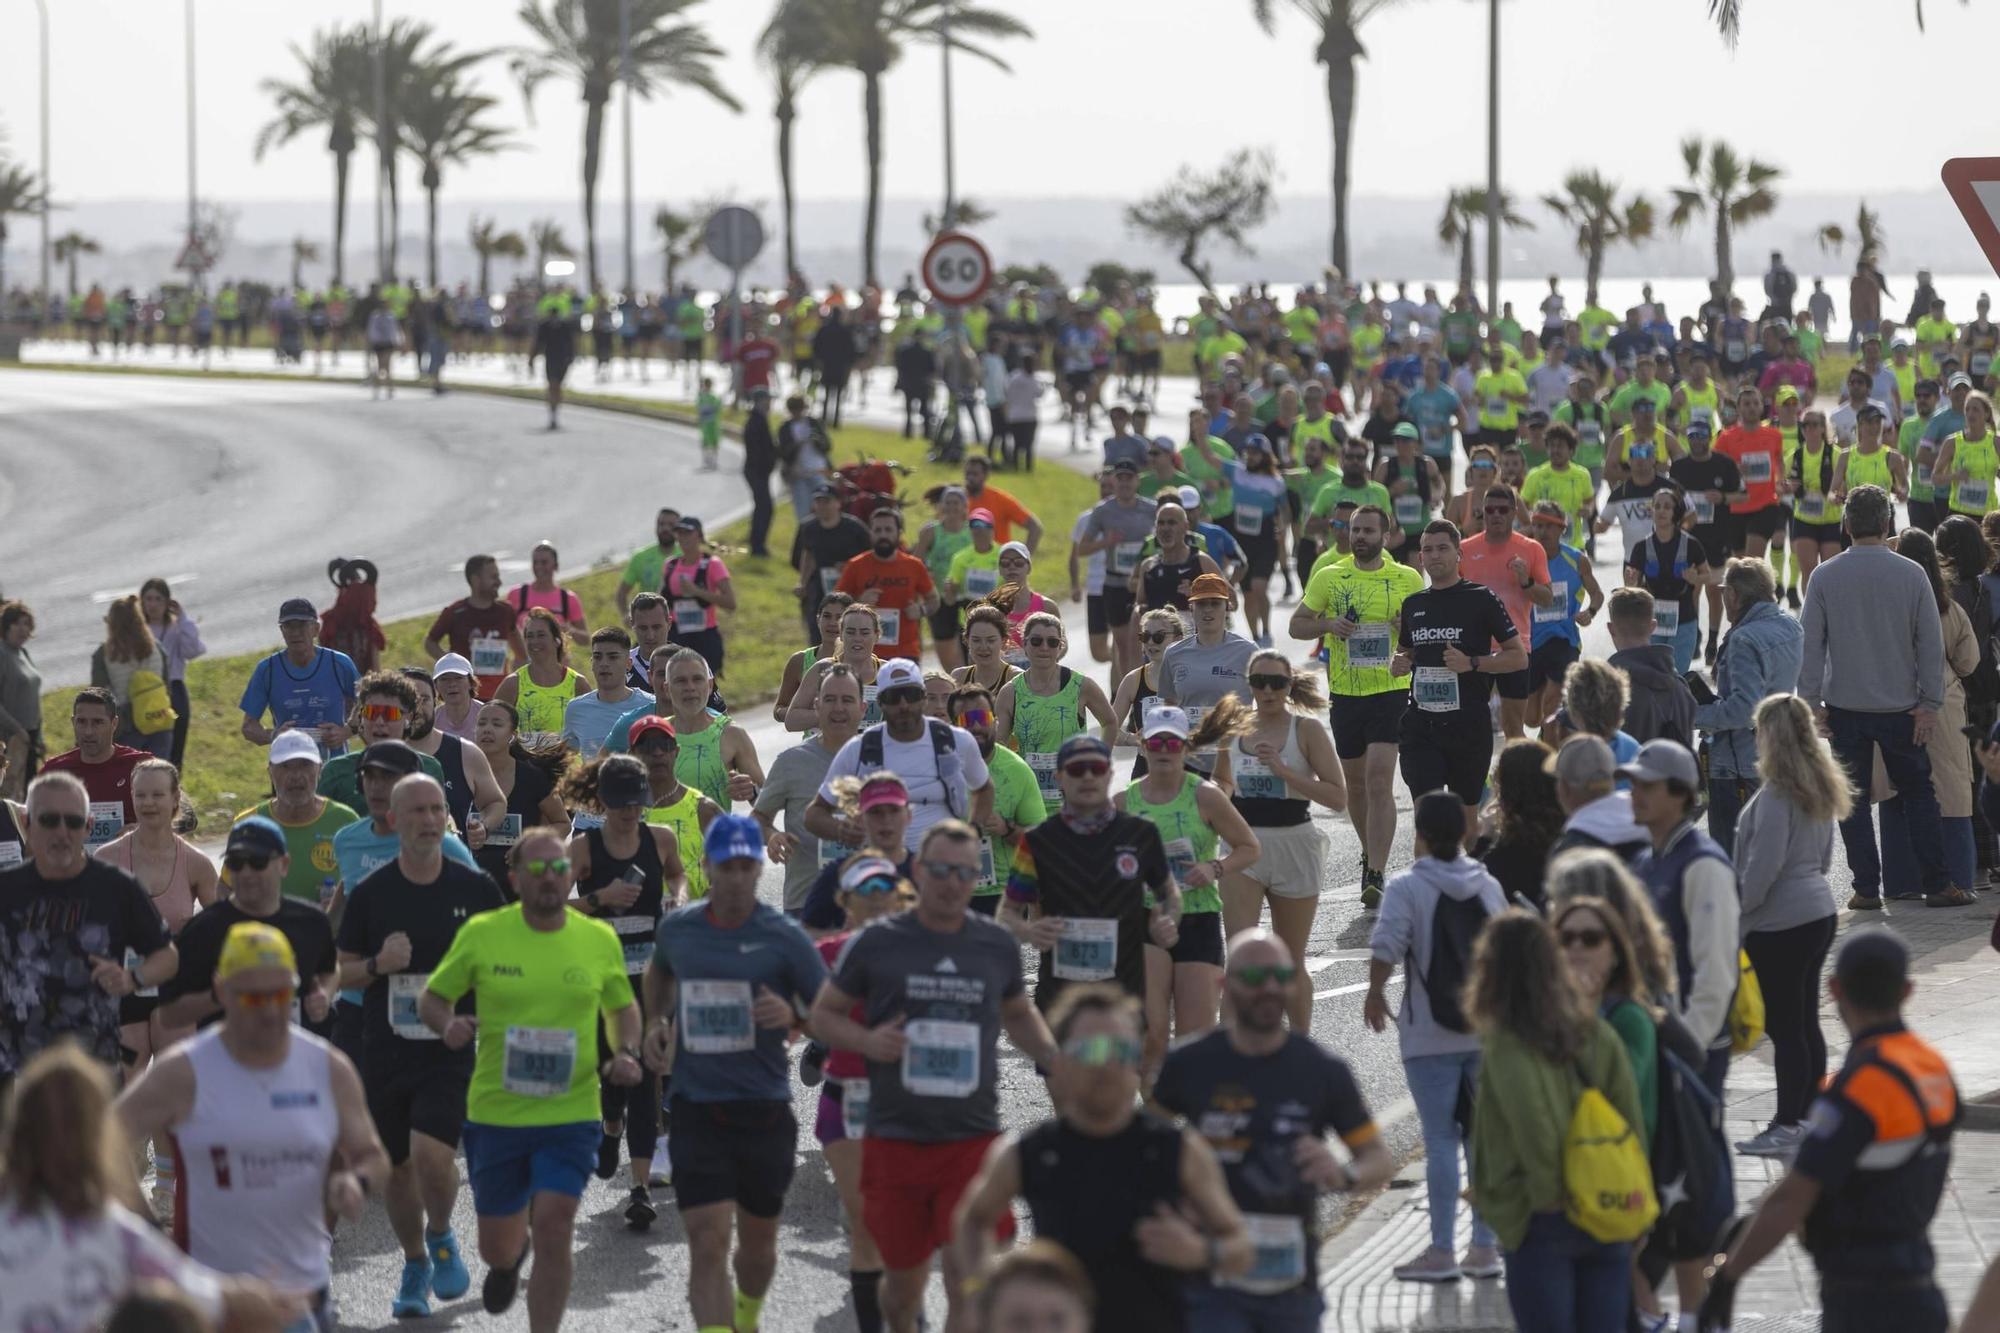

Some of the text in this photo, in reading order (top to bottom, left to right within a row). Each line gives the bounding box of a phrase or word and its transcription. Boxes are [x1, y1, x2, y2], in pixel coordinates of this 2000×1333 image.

[938, 257, 978, 282] 60
[1360, 640, 1379, 651] 927
[1423, 684, 1450, 696] 1149
[1250, 778, 1273, 792] 390
[1071, 943, 1099, 959] 673
[906, 988, 983, 1003] MARATHON
